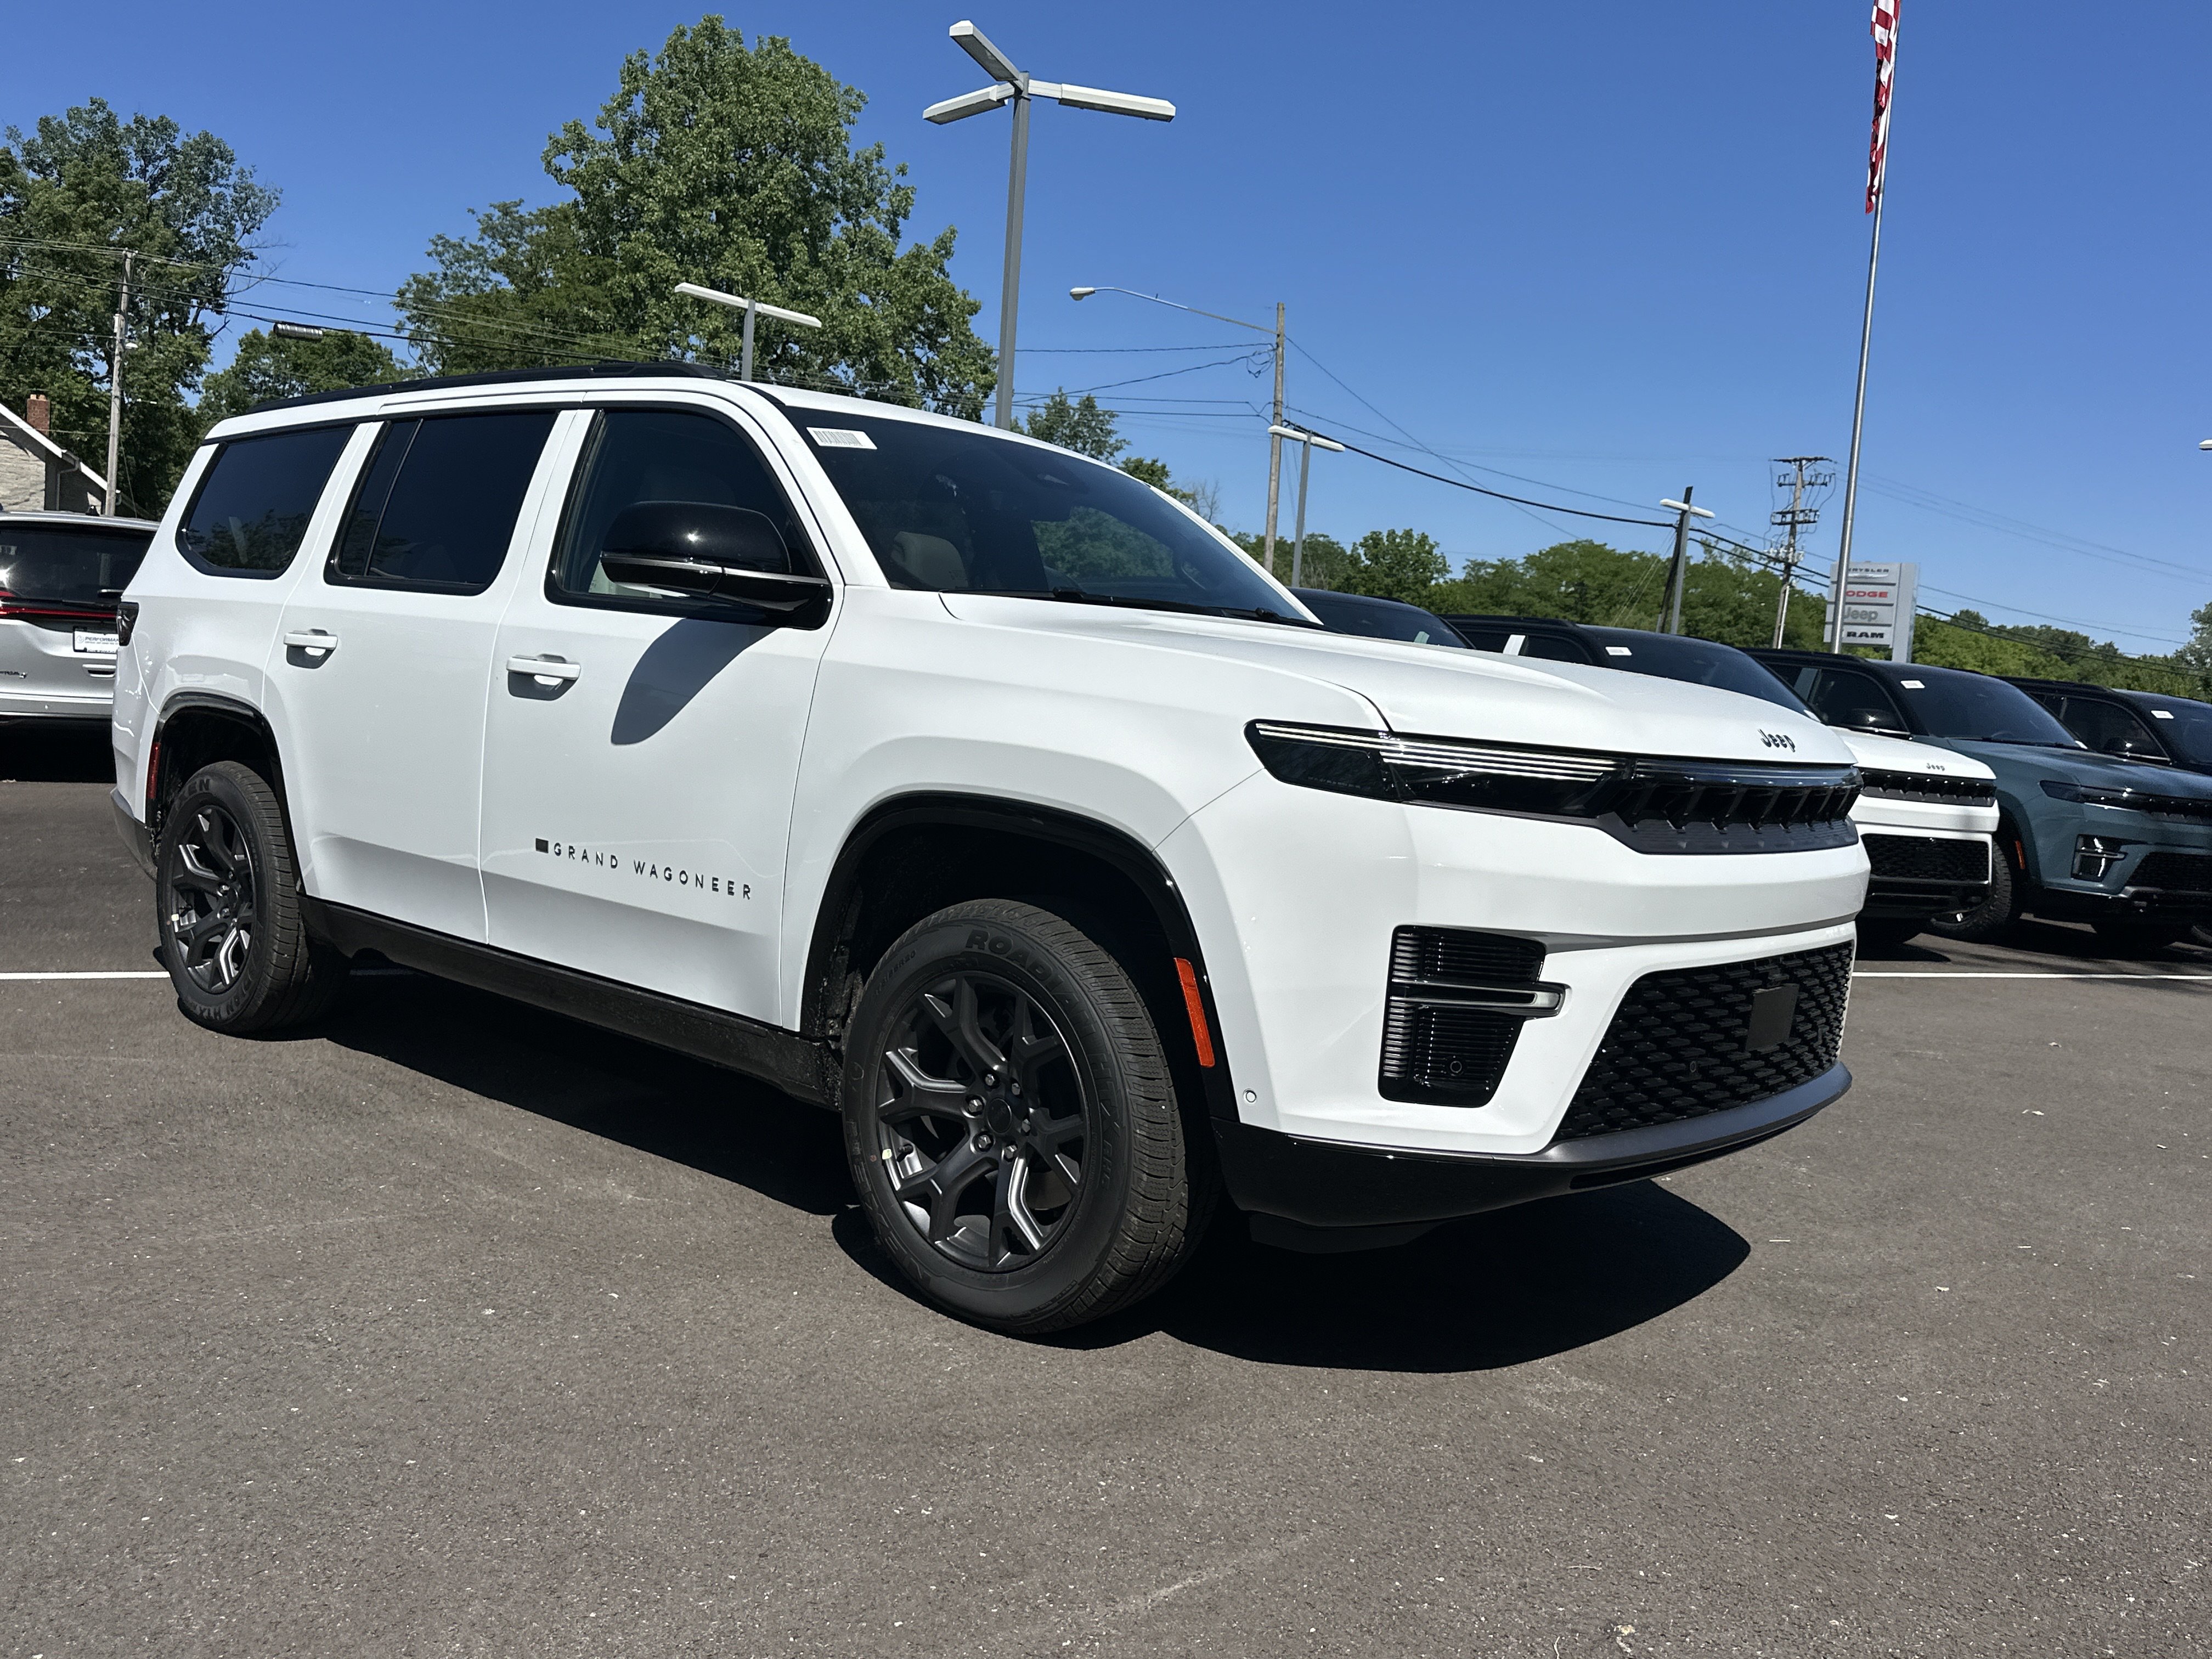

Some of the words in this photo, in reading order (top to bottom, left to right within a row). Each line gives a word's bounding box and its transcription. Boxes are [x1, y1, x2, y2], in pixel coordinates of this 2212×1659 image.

[1846, 590, 1888, 598] ODGE
[1843, 606, 1878, 622] Jeep
[1757, 729, 1796, 753] Jeep
[1926, 763, 1945, 771] Jeep
[554, 842, 618, 869] GRAND
[634, 859, 751, 900] WAGONEER
